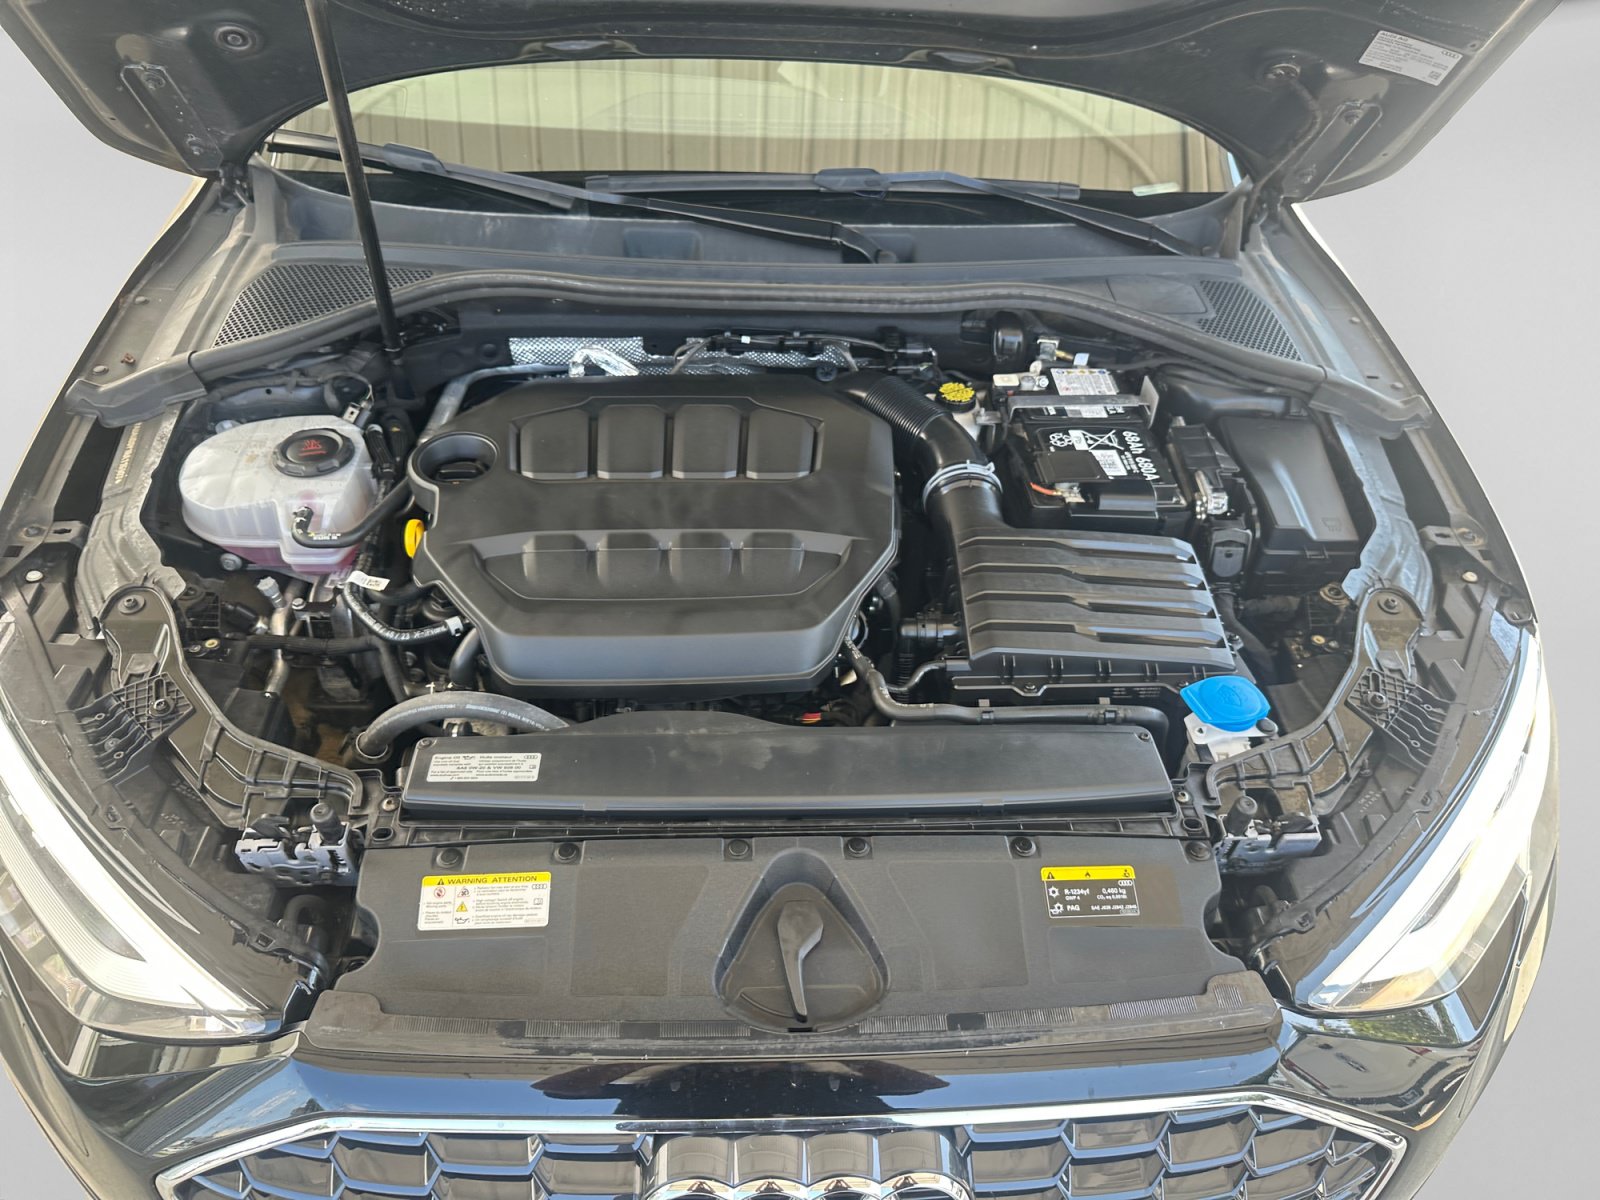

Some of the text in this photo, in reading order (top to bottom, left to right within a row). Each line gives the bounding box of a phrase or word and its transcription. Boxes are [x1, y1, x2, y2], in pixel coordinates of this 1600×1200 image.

[1122, 430, 1146, 454] 68Ah
[1135, 456, 1160, 481] 680A
[447, 875, 537, 885] WARNING ATTENTION
[1064, 888, 1090, 896] R-1234yf
